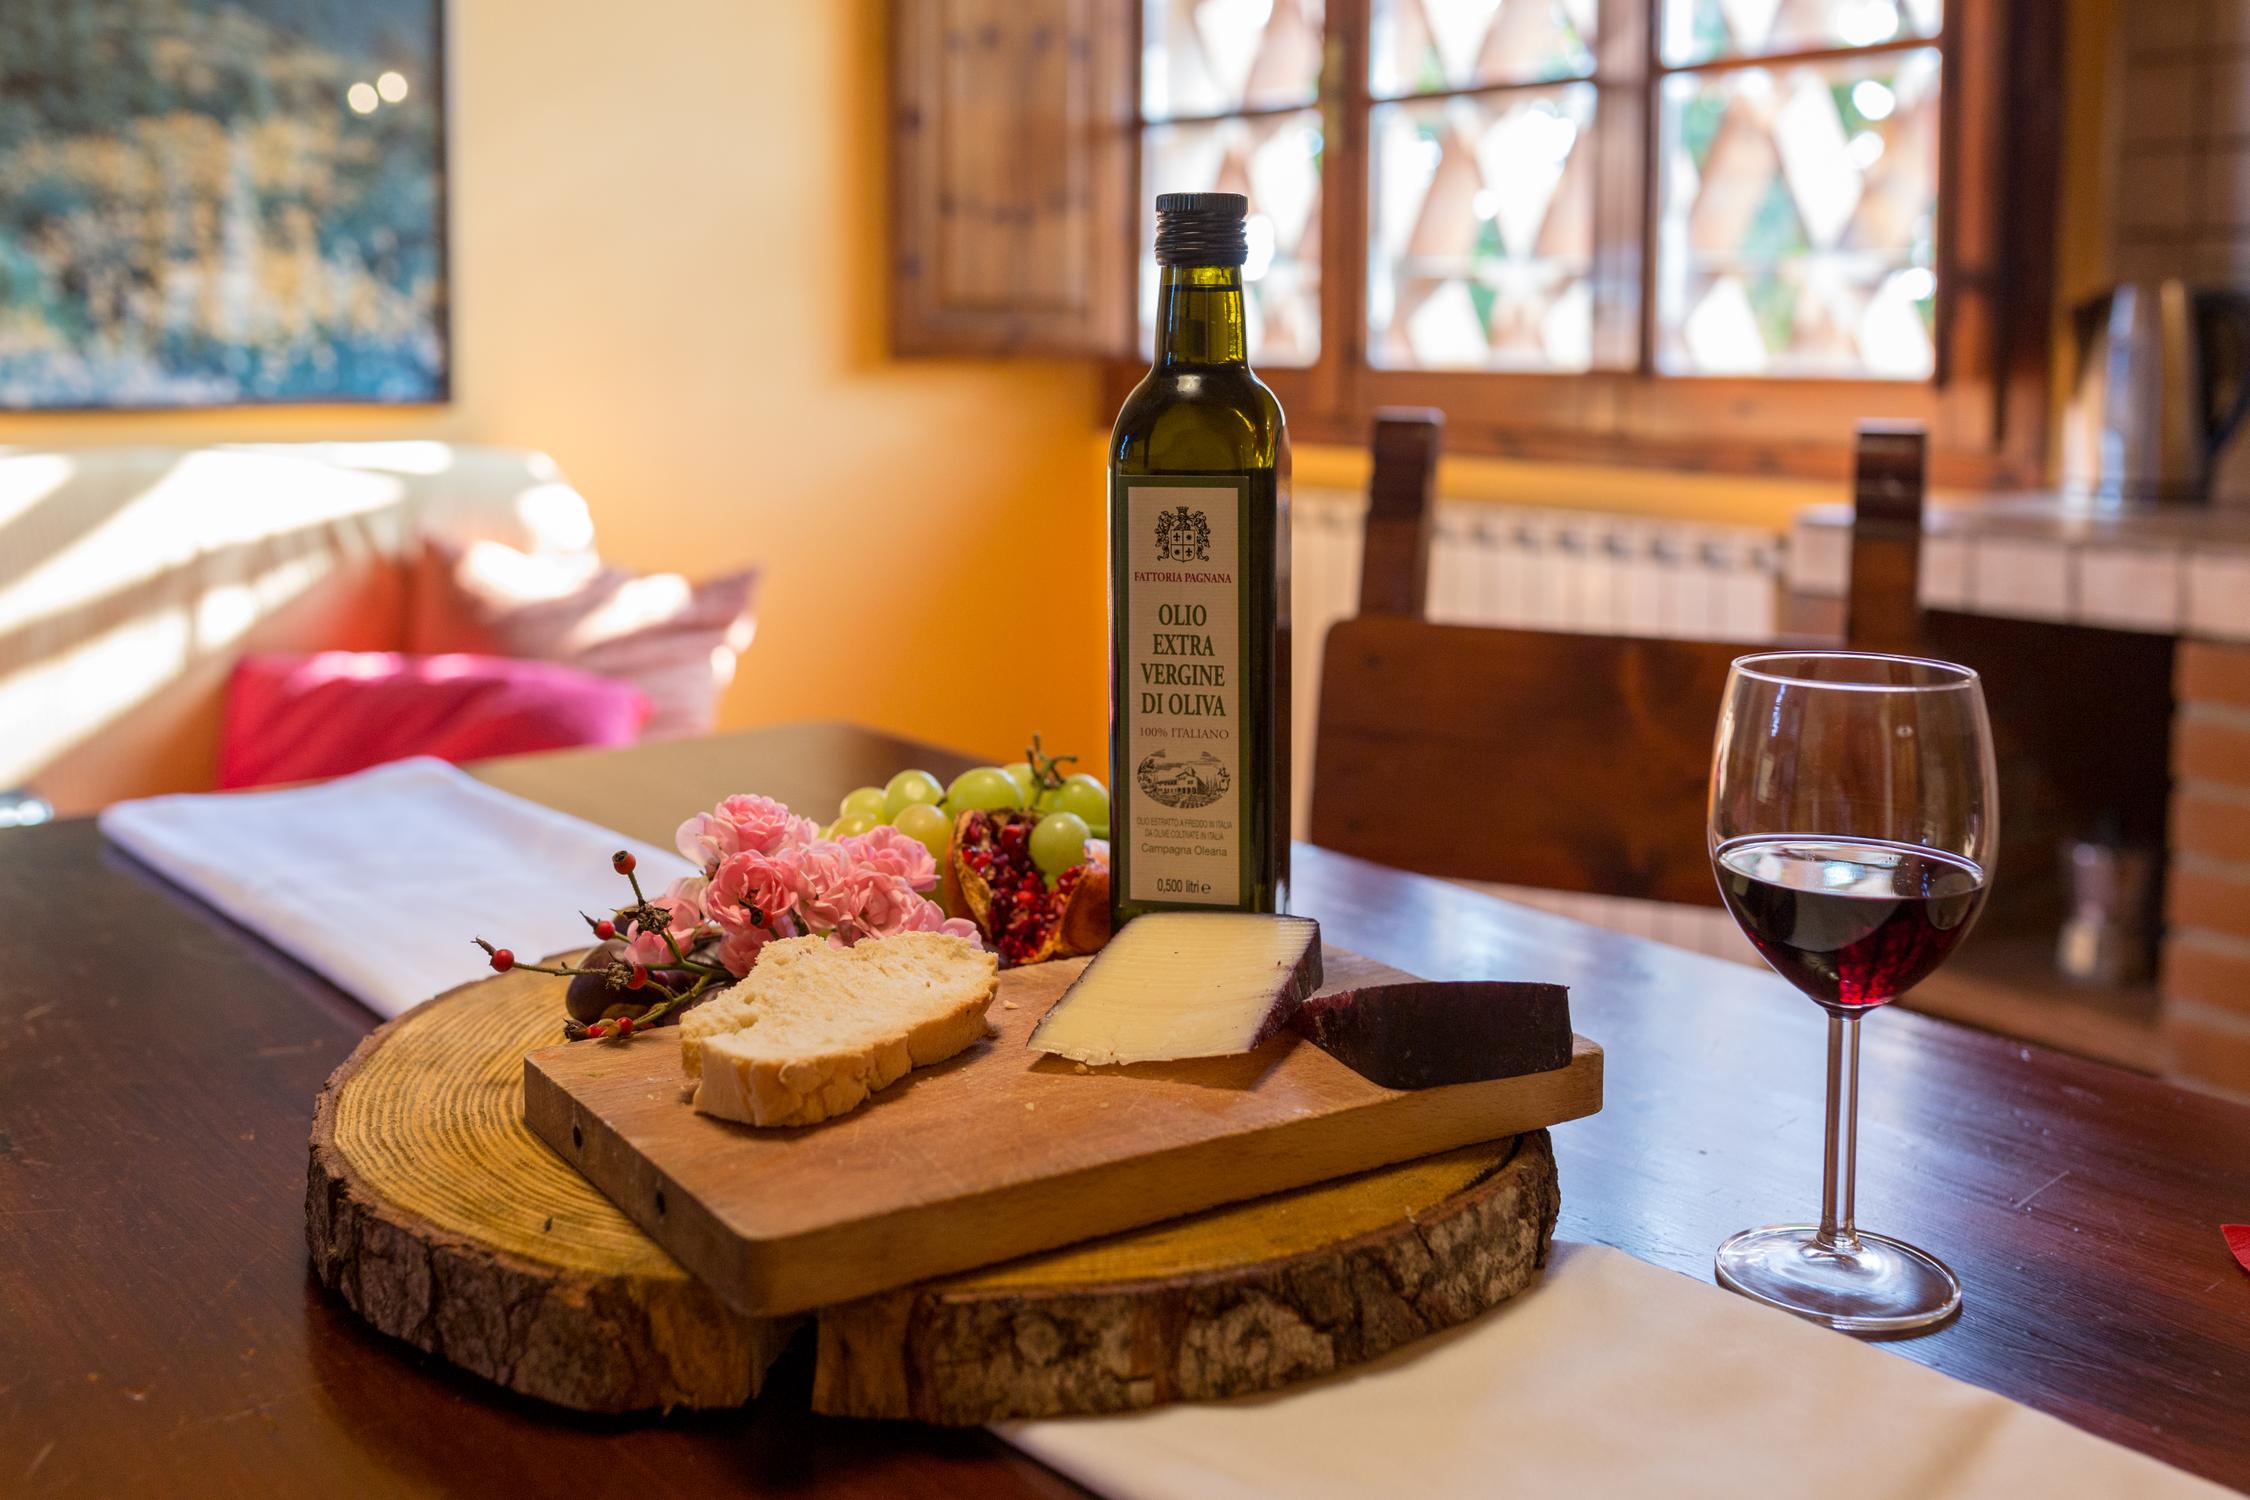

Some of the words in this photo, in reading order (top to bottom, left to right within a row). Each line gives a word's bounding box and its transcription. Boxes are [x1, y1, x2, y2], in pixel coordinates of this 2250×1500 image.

[1134, 571, 1182, 583] FATTORIA
[1185, 572, 1232, 584] PAGNANA
[1158, 603, 1207, 627] OLIO
[1152, 633, 1215, 657] EXTRA
[1140, 662, 1226, 687] VERGINE
[1141, 692, 1163, 715] DI
[1168, 693, 1226, 717] OLIVA
[1140, 727, 1168, 738] 100%
[1171, 727, 1229, 740] ITALIANO
[1141, 843, 1192, 857] Campagna
[1157, 878, 1183, 894] 0,500
[1185, 879, 1200, 893] litri
